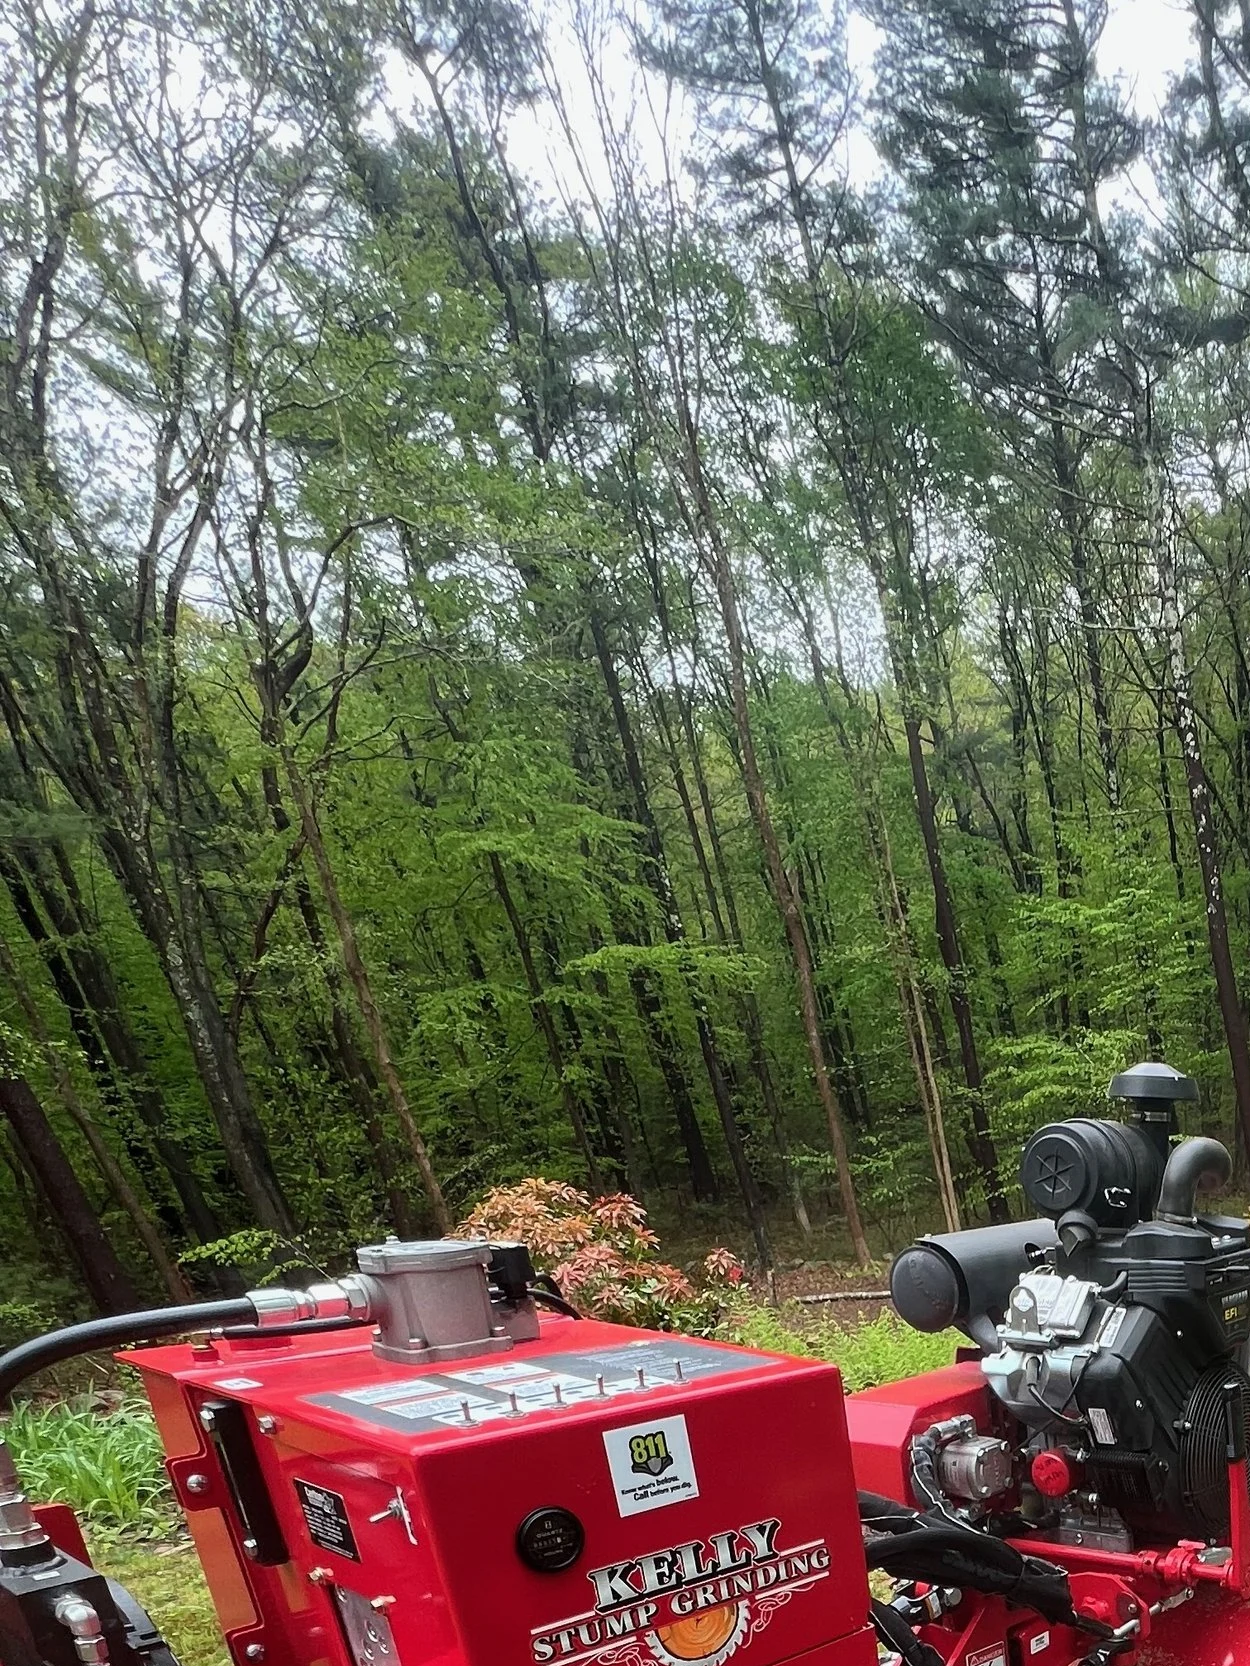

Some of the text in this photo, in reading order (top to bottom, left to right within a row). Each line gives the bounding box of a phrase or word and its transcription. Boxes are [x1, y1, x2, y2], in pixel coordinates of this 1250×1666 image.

[1224, 1307, 1238, 1320] EFI
[630, 1433, 667, 1463] 811
[633, 1490, 650, 1501] Call
[589, 1519, 780, 1612] KELLY
[532, 1548, 831, 1662] STUMP GRINDING
